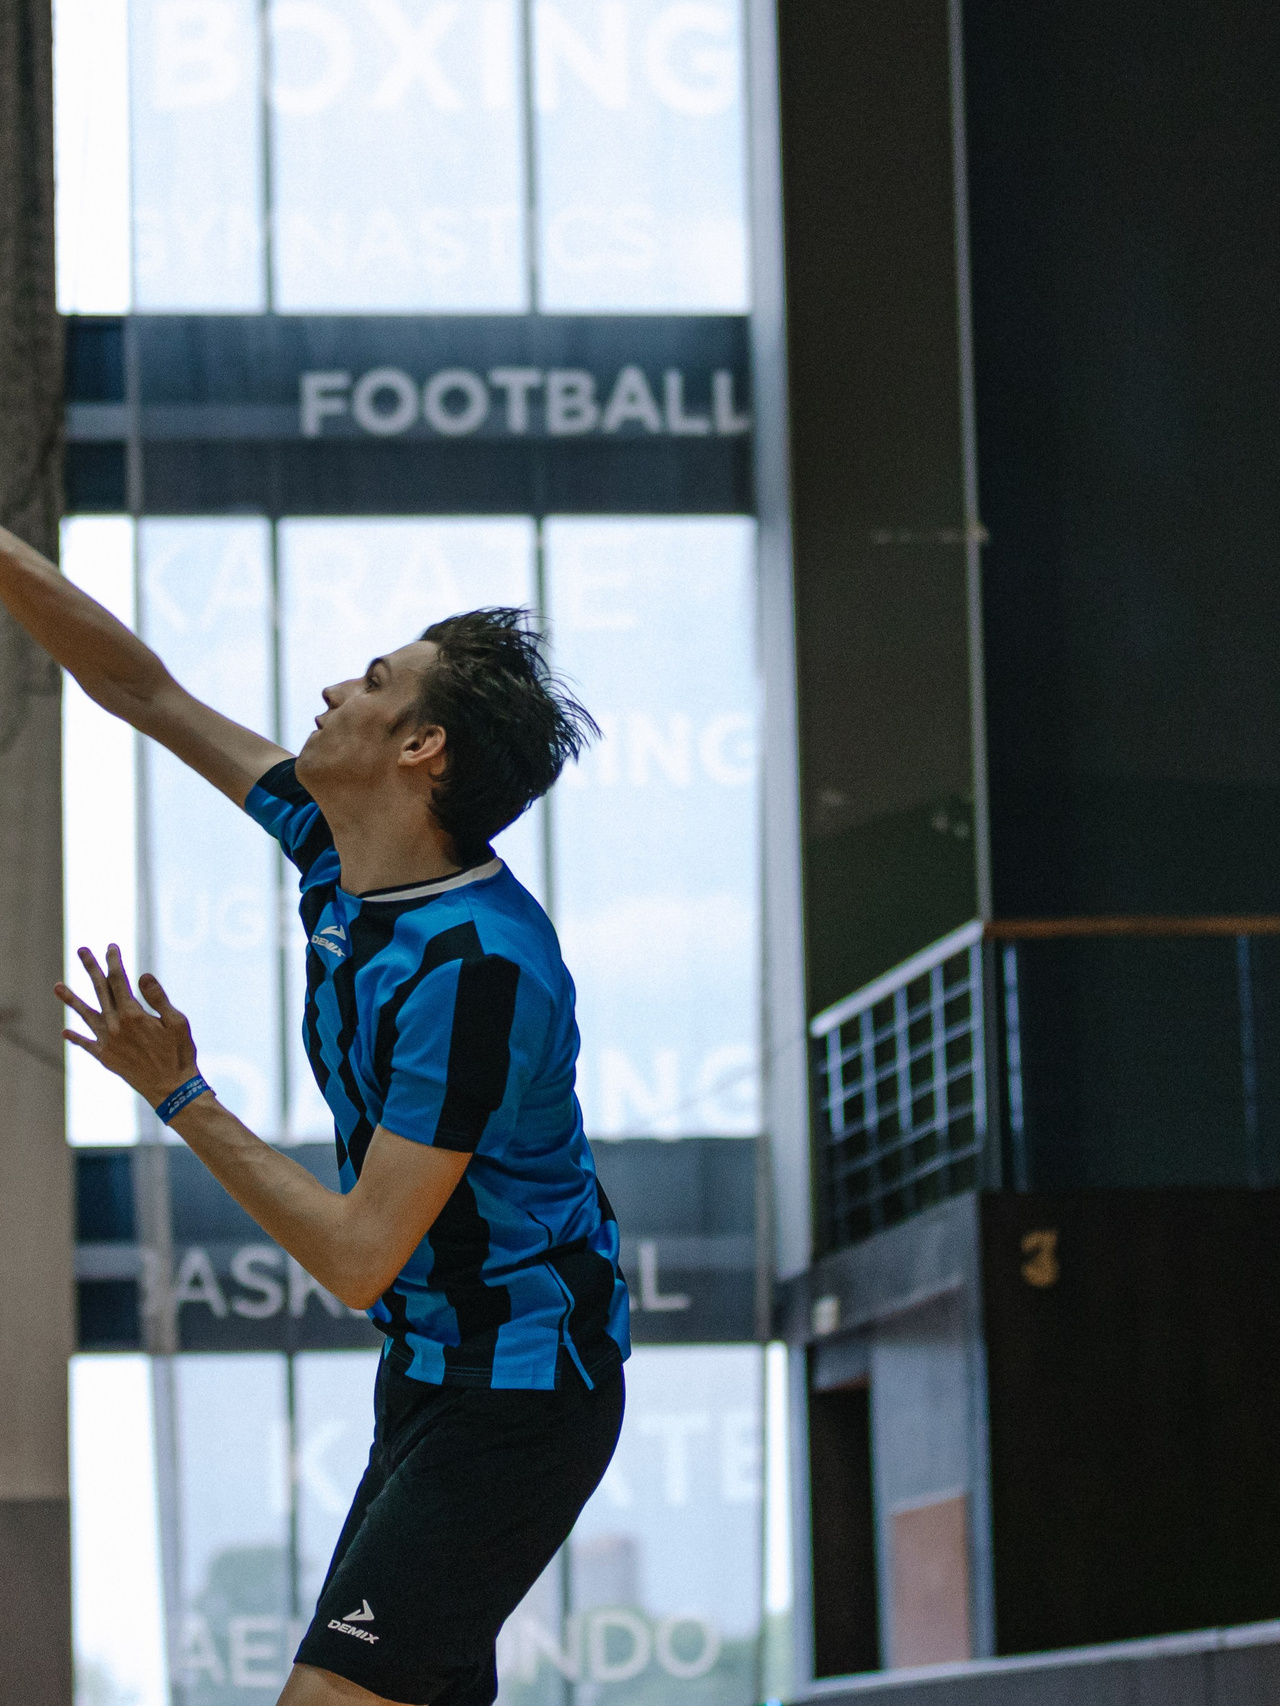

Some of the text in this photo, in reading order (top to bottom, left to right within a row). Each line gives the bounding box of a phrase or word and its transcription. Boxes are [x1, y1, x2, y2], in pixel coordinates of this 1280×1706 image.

[152, 0, 738, 114] BOXING
[300, 366, 752, 438] FOOTBALL
[327, 1619, 380, 1645] DEMIX
